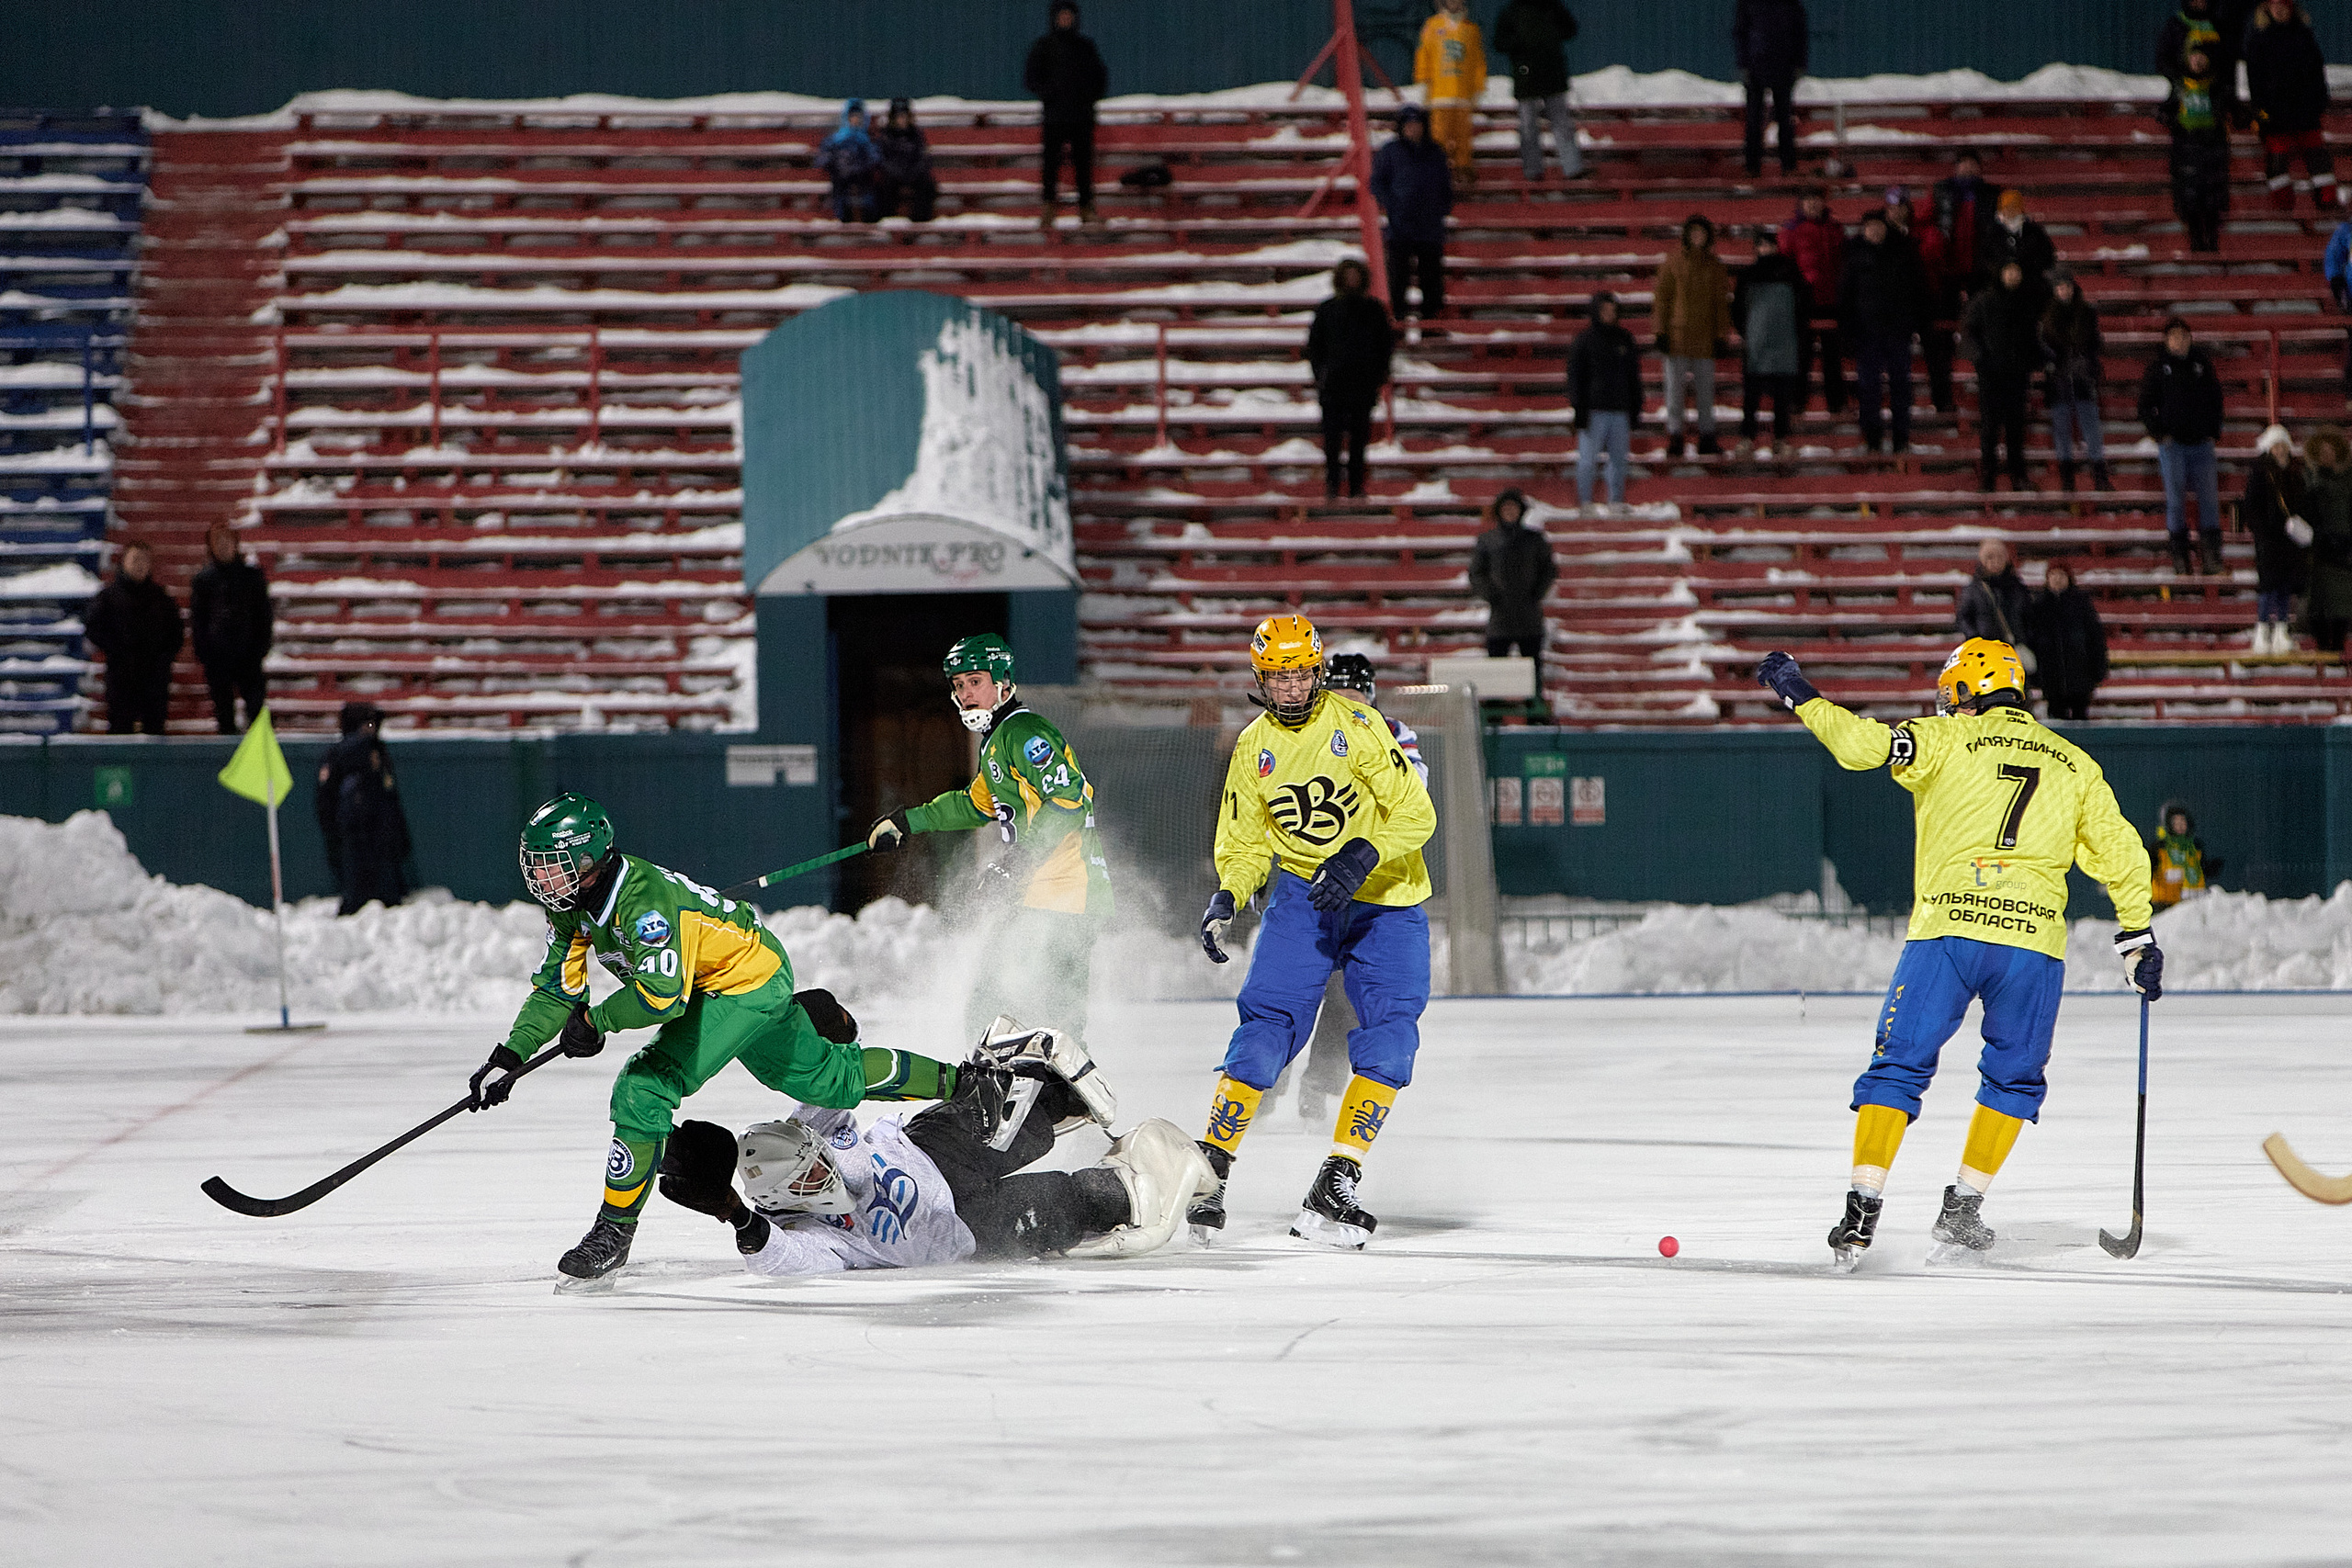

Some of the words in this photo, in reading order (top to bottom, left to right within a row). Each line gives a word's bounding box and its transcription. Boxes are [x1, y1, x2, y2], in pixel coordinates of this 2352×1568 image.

[1995, 763, 2041, 851] 7
[1995, 879, 2028, 890] group
[1949, 908, 2038, 934] ОБЛАСТЬ
